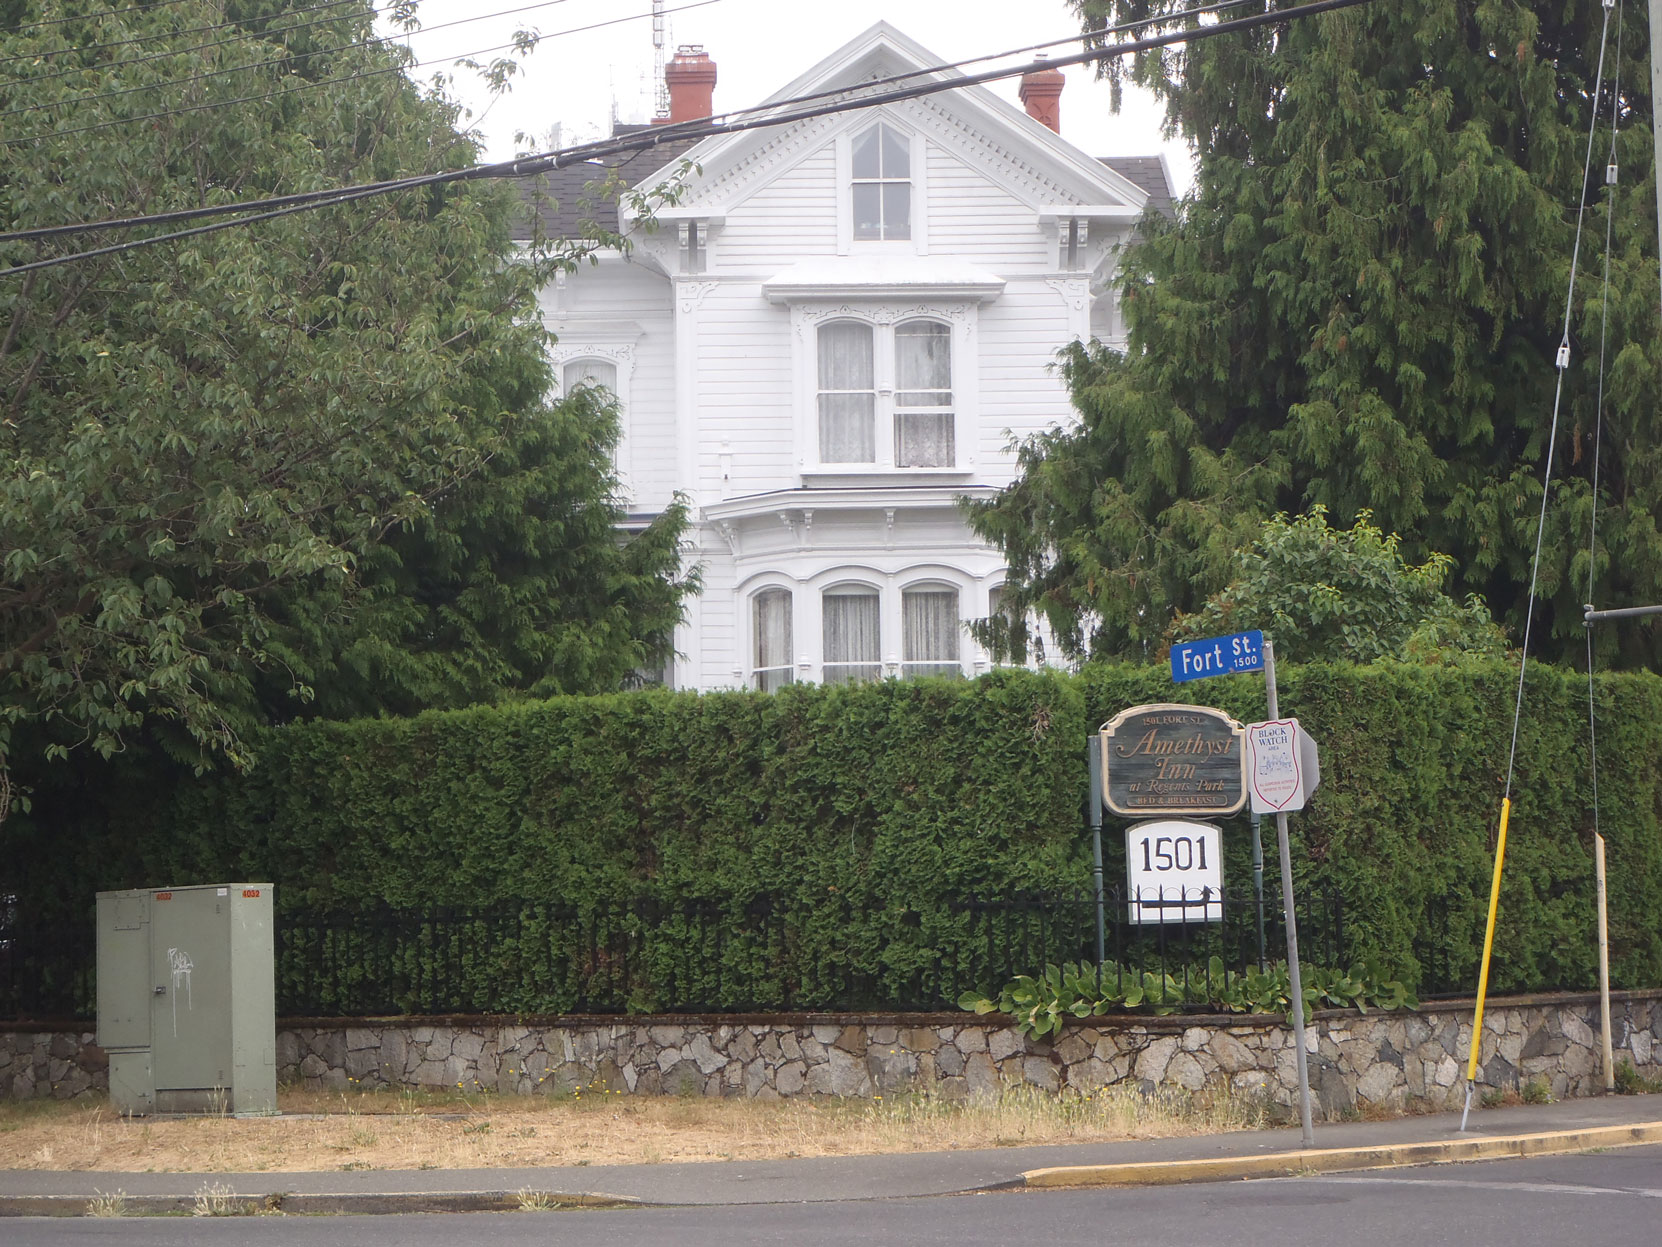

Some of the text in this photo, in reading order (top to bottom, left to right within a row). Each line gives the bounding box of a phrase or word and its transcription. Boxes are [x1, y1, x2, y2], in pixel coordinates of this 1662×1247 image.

[1182, 636, 1256, 674] Fort St.
[1234, 655, 1257, 667] 1500
[1163, 715, 1188, 725] FORT
[1258, 727, 1287, 738] BLOCK
[1115, 728, 1233, 763] Amethyst
[1258, 735, 1288, 746] WATCH
[1155, 757, 1196, 780] Inn
[1129, 779, 1225, 794] at Regents Park
[1137, 796, 1156, 805] BED
[1167, 796, 1217, 805] BREAKFAST
[1140, 835, 1208, 872] 1501
[242, 889, 260, 898] 4032
